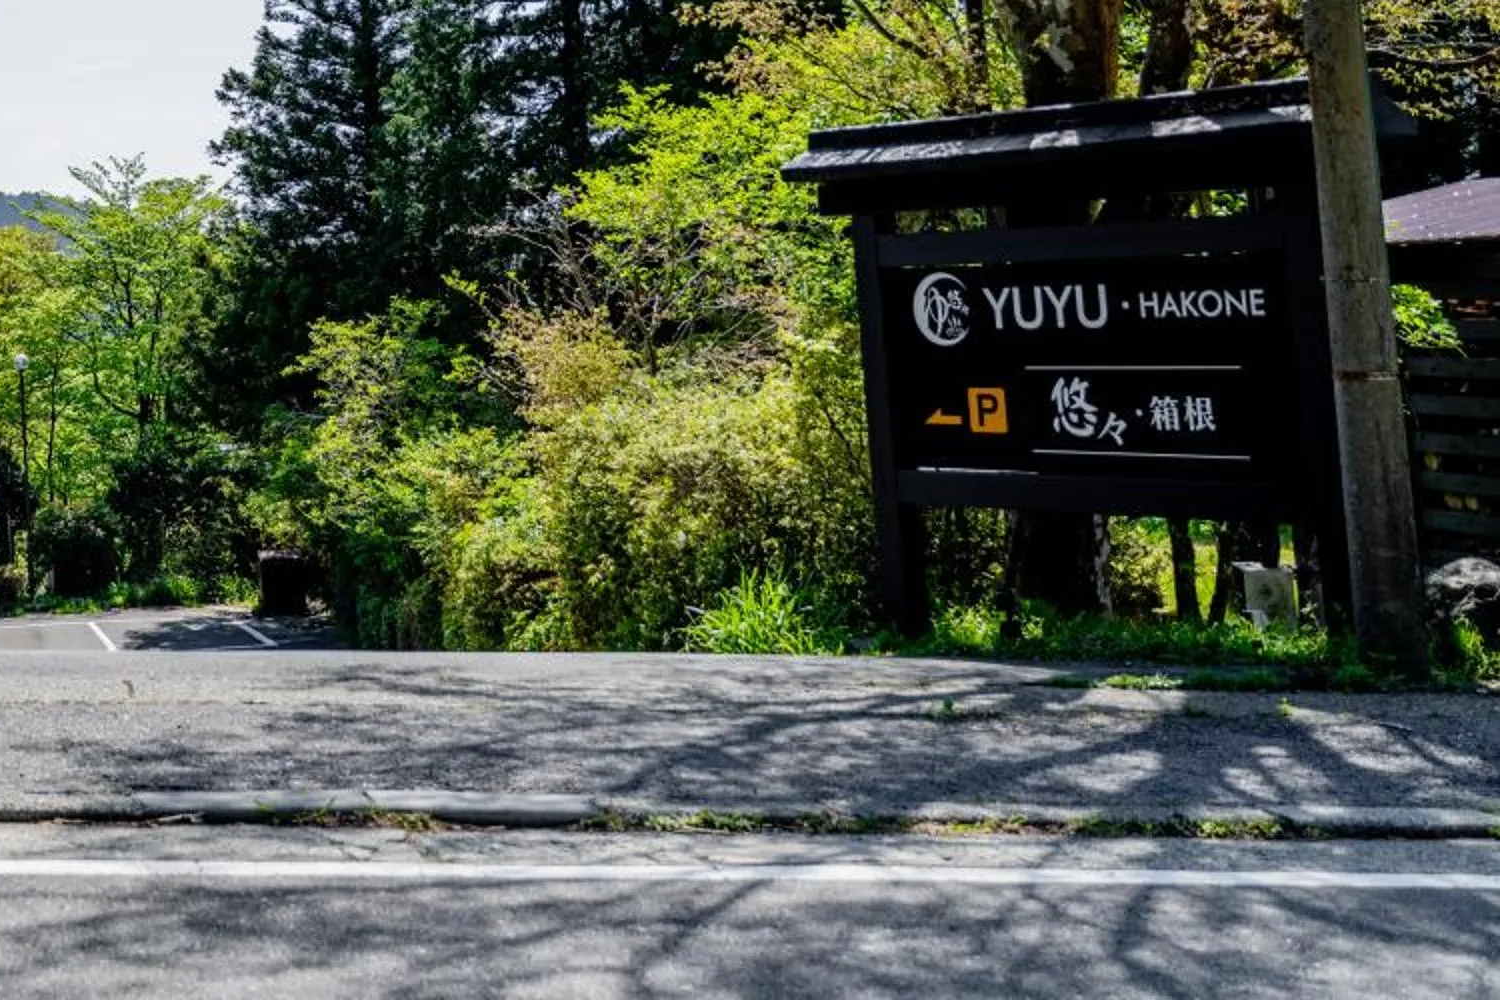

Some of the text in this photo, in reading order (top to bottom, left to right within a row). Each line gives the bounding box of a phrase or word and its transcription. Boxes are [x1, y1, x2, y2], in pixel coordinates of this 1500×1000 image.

[982, 283, 1266, 330] YUYU HAKONE
[977, 393, 999, 427] P
